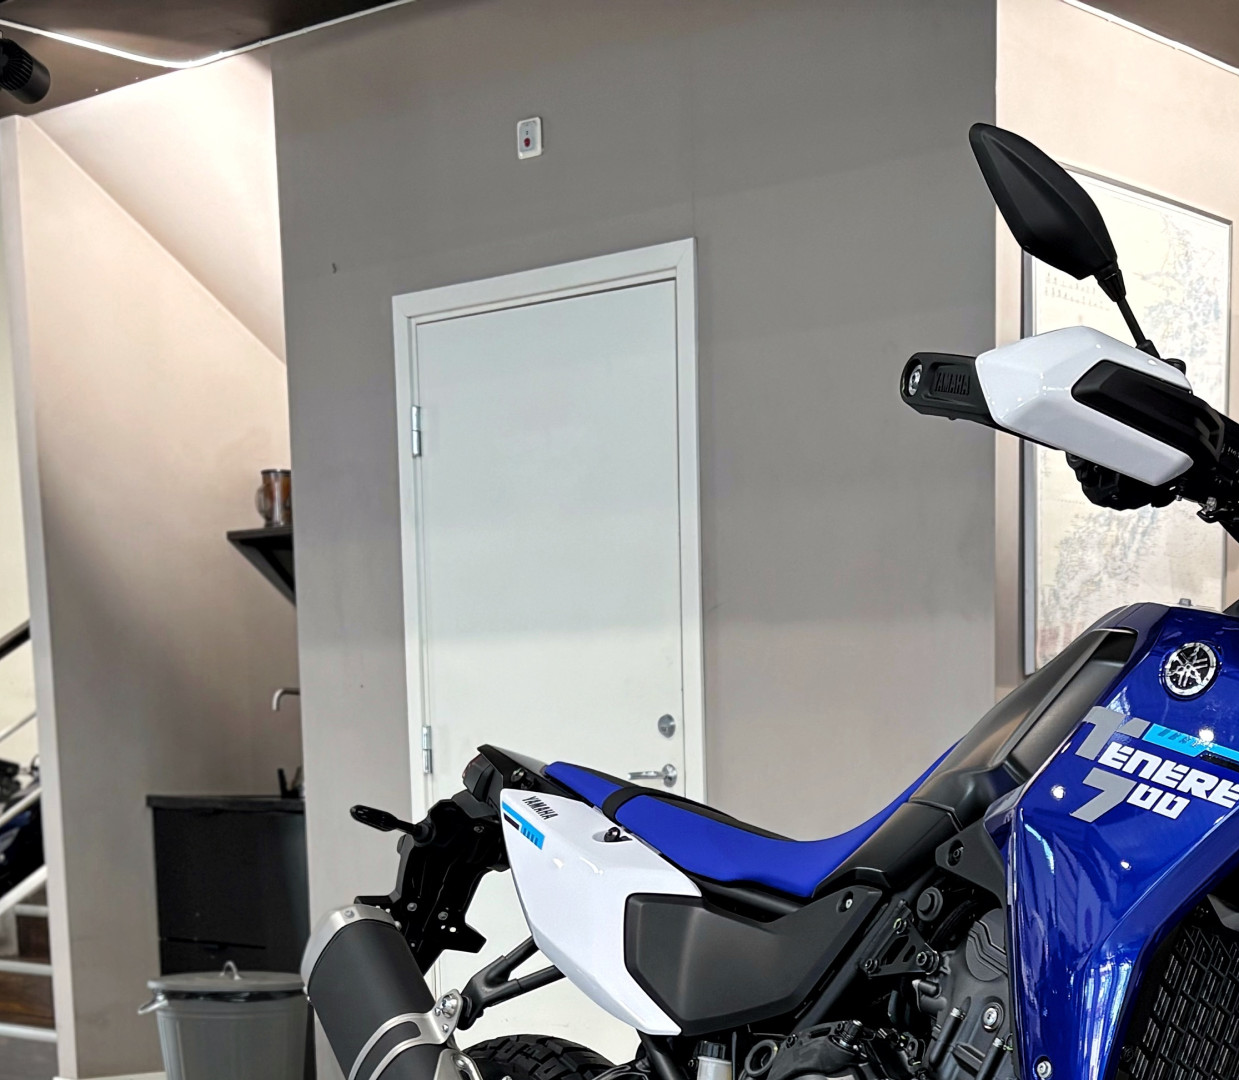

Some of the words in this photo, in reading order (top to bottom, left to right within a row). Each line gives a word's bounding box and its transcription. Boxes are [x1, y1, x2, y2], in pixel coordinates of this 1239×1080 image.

[933, 371, 970, 396] YAMAHA
[522, 795, 559, 820] YAMAHA
[1069, 767, 1191, 823] 700
